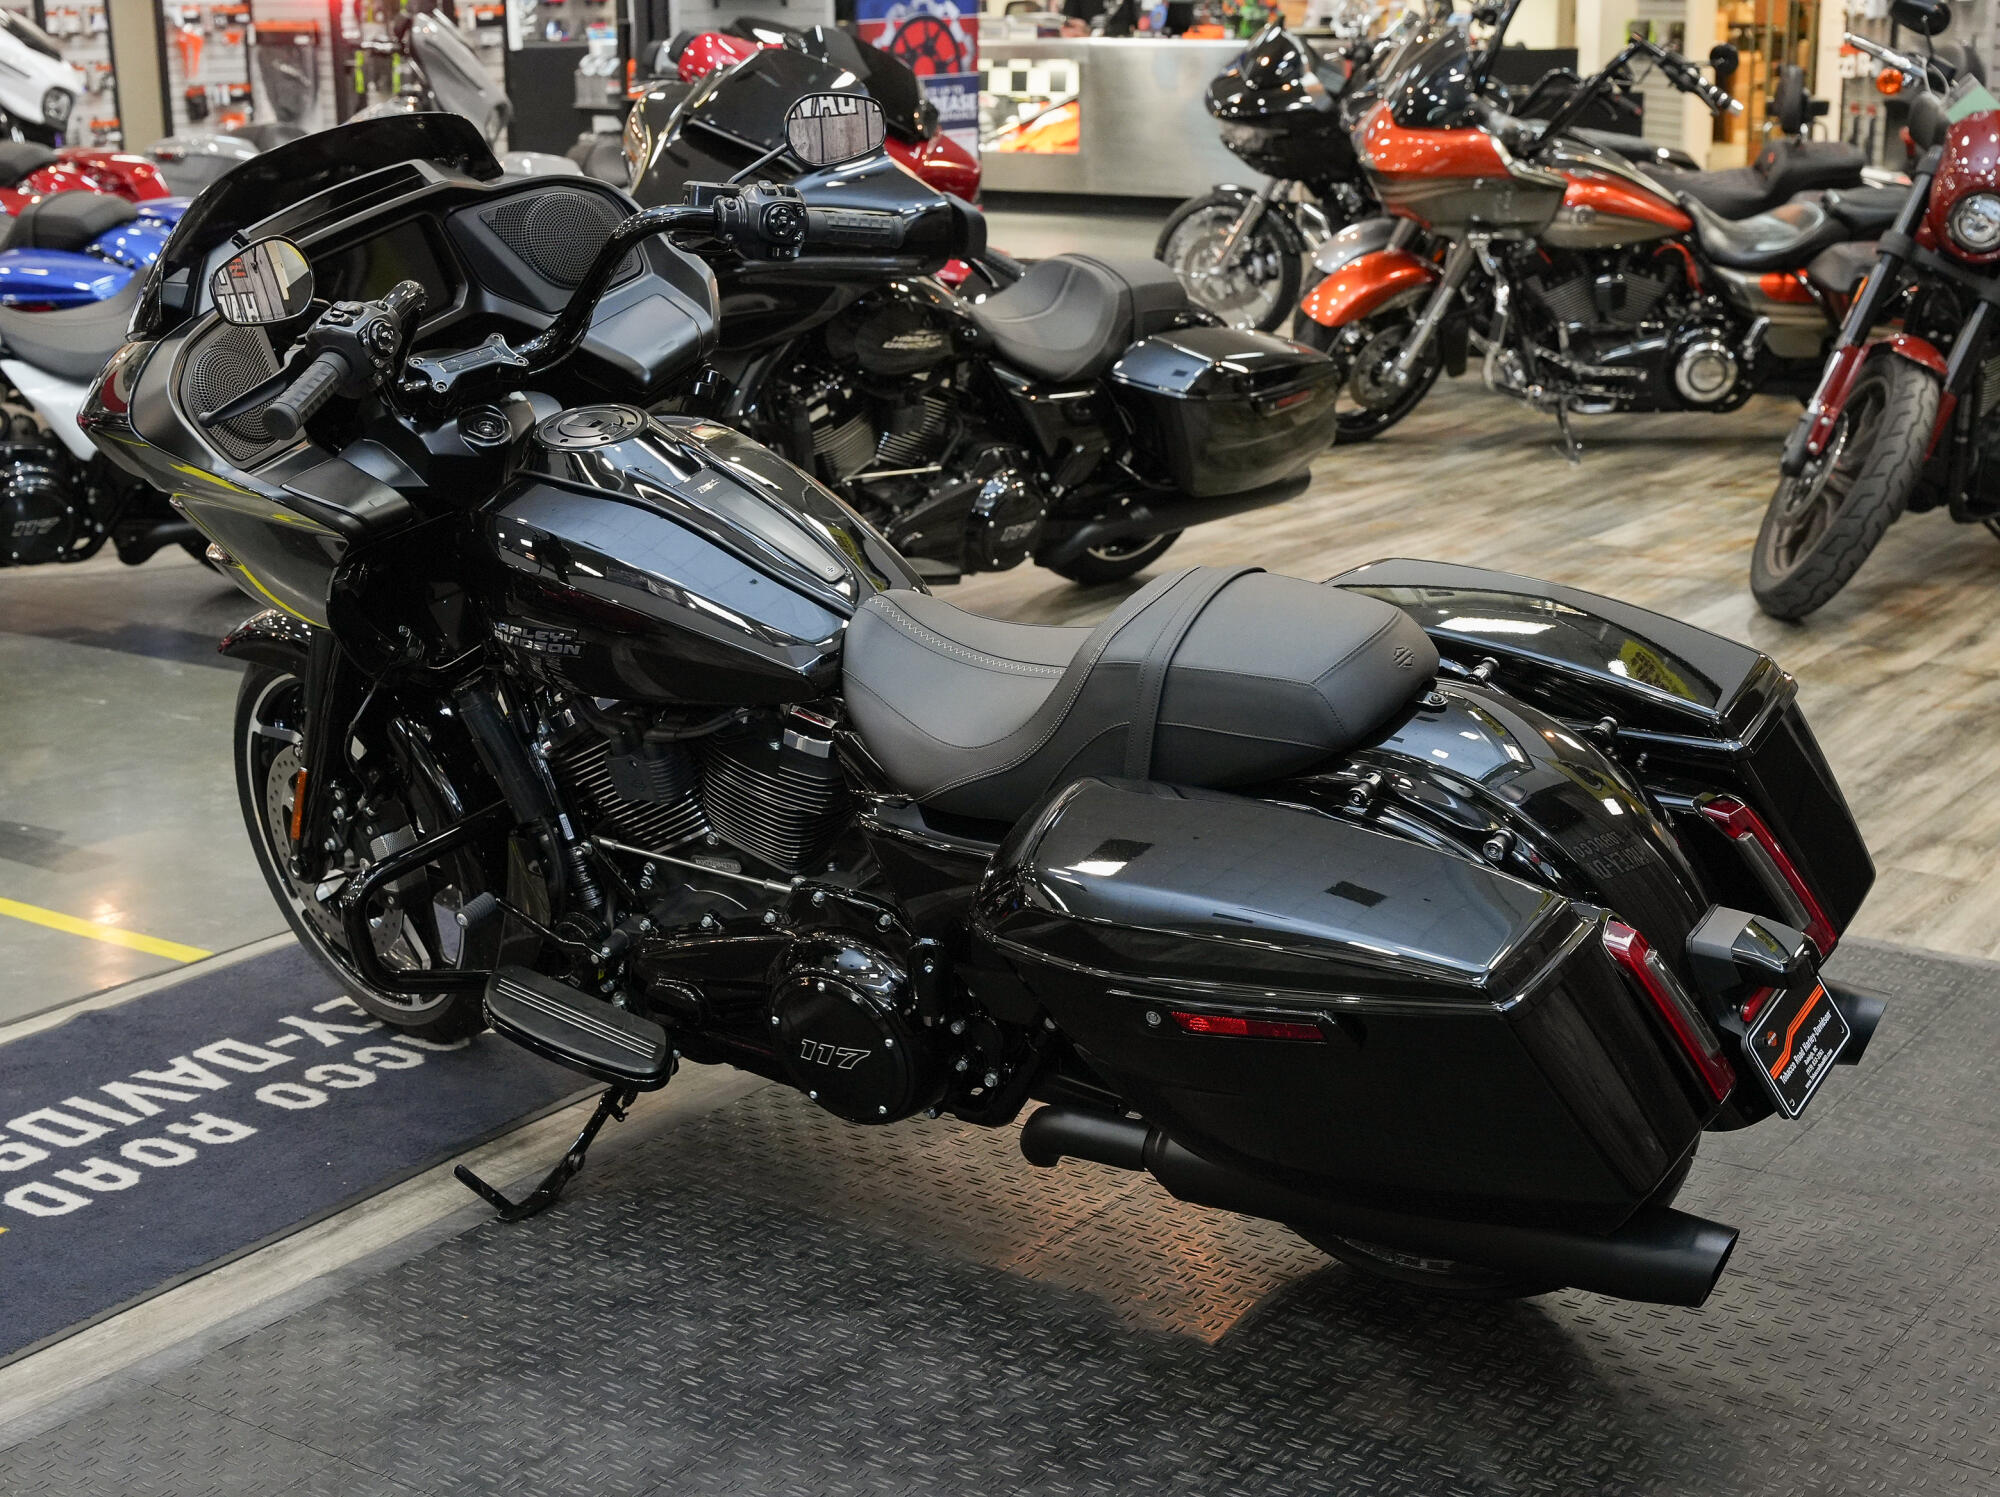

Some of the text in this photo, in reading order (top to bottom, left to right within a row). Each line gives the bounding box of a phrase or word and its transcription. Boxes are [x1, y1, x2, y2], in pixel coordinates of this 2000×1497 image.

[493, 622, 572, 642] ARLEY-
[494, 629, 581, 656] AVIDSON
[800, 1038, 871, 1071] 117
[1779, 1061, 1797, 1085] Tobacco
[1793, 1046, 1806, 1065] Road
[3, 1112, 258, 1217] ROAD
